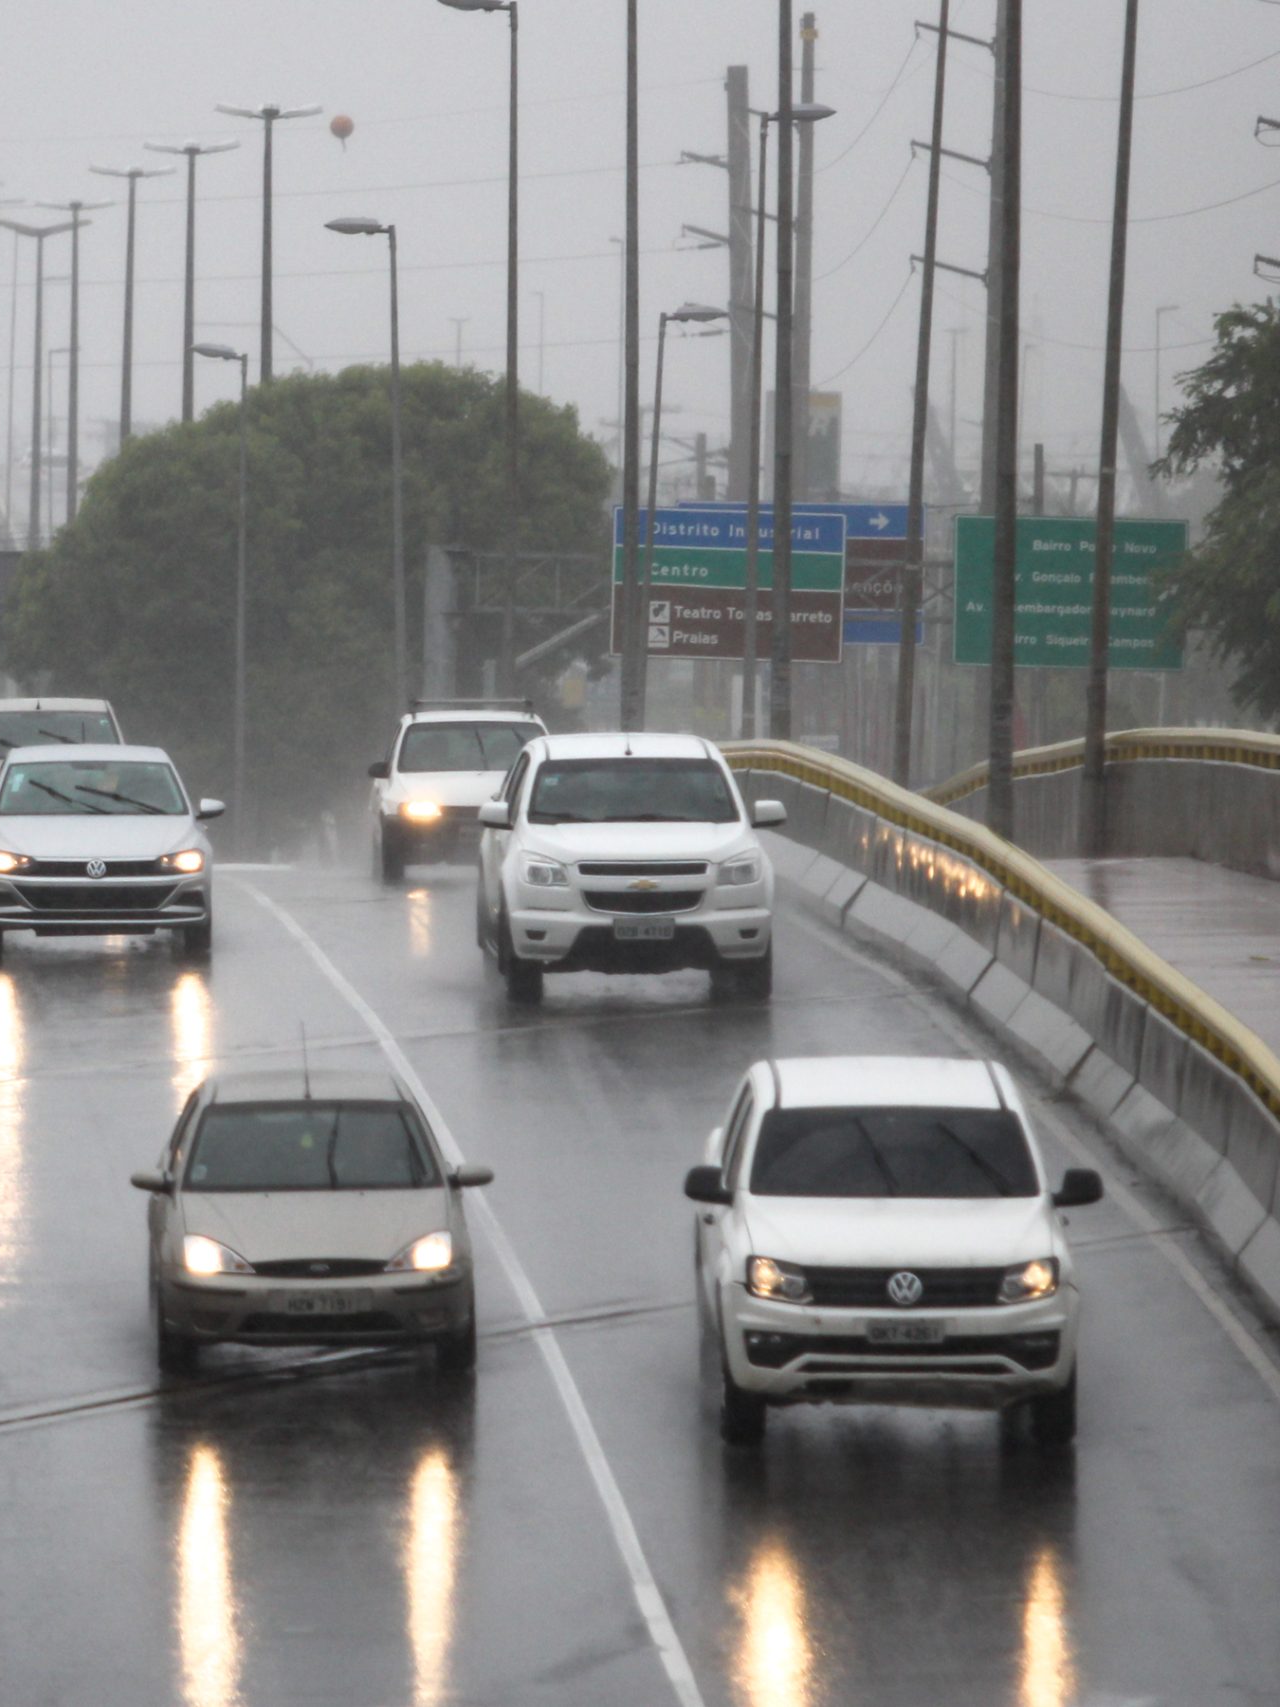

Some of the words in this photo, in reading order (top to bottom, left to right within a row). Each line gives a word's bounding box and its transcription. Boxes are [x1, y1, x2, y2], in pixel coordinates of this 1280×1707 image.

[1032, 539, 1072, 551] Bairro
[1124, 542, 1157, 554] Novo
[650, 562, 709, 577] Centro
[673, 604, 721, 619] Teatro
[726, 607, 773, 621] Toas
[790, 610, 833, 624] arreto
[1015, 602, 1091, 617] embargador
[1110, 606, 1156, 618] aynard
[671, 630, 718, 645] Praias
[1014, 634, 1037, 645] irro
[1045, 634, 1089, 647] Siqueir
[1109, 636, 1155, 648] ampos
